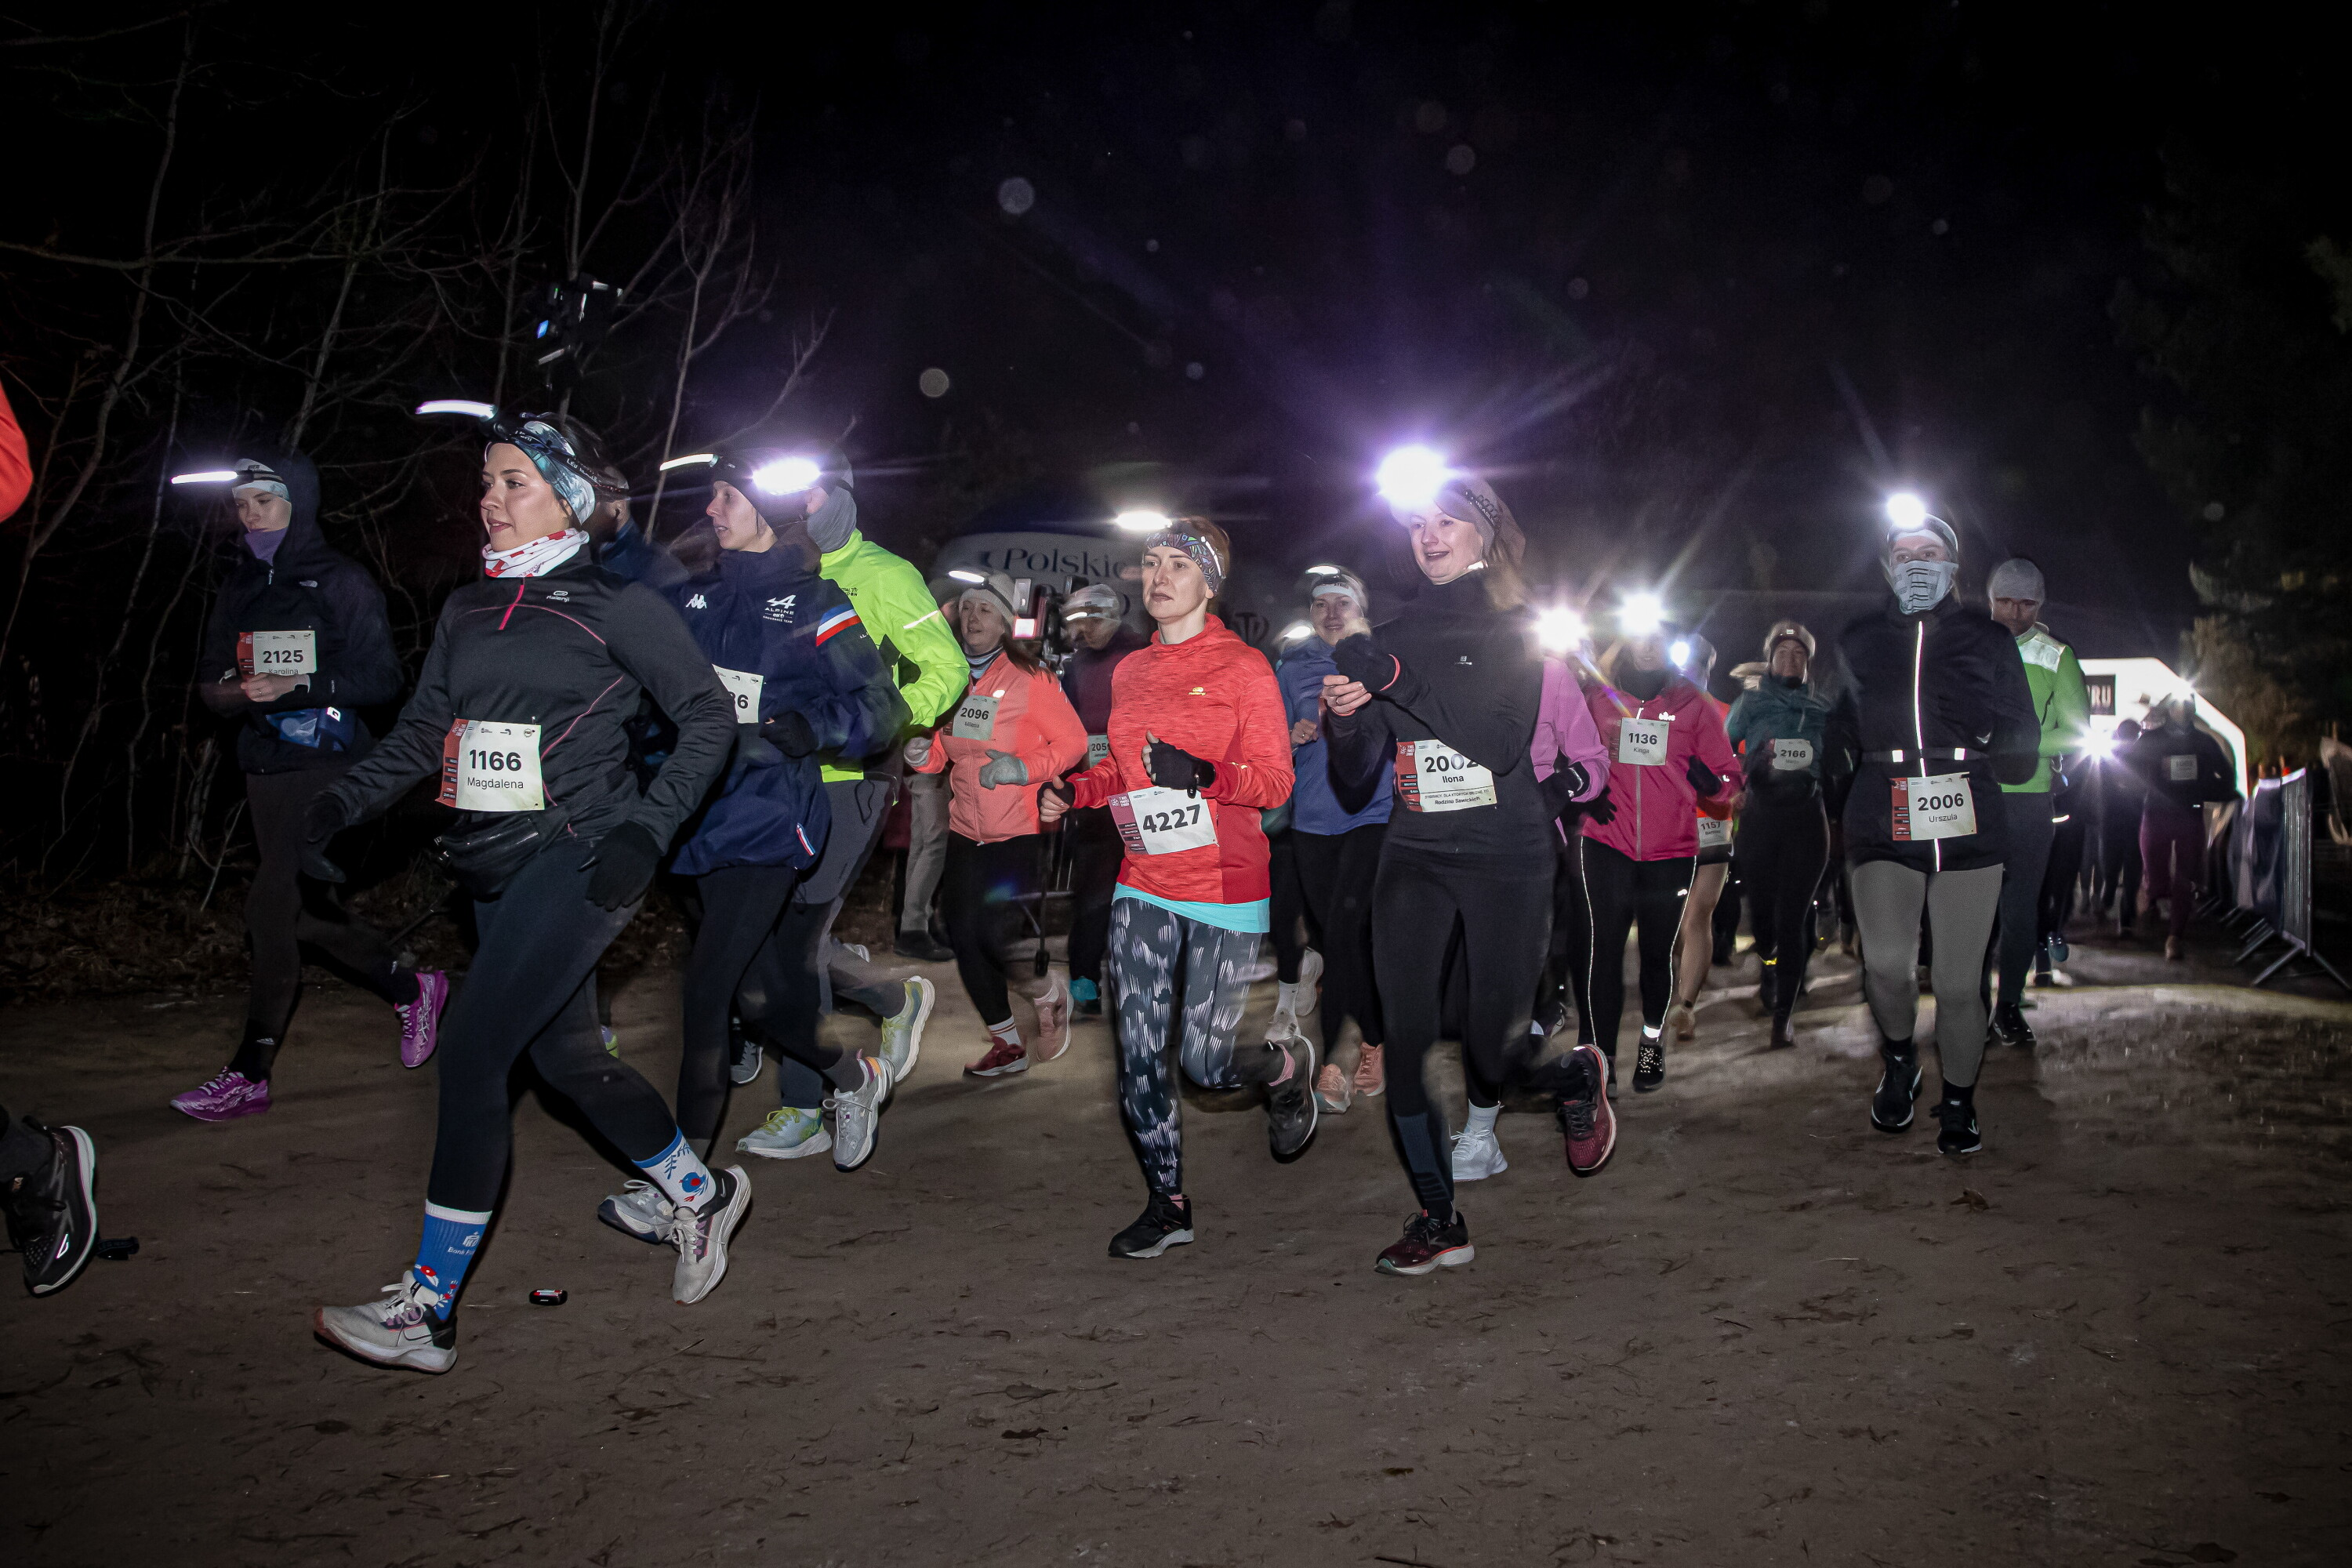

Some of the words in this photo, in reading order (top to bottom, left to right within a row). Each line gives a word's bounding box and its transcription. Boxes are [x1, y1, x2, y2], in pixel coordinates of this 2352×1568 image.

[764, 607, 794, 615] ALPINE
[263, 649, 304, 664] 2125
[2087, 684, 2111, 707] RU
[960, 707, 989, 720] 2096
[1628, 732, 1658, 745] 1136
[469, 749, 522, 771] 1166
[1780, 750, 1806, 758] 2166
[467, 776, 524, 790] Magdalena
[1917, 793, 1964, 811] 2006
[1142, 804, 1201, 833] 4227
[1929, 814, 1958, 822] Urszula
[1701, 821, 1721, 830] 1157
[447, 1247, 465, 1255] Bank
